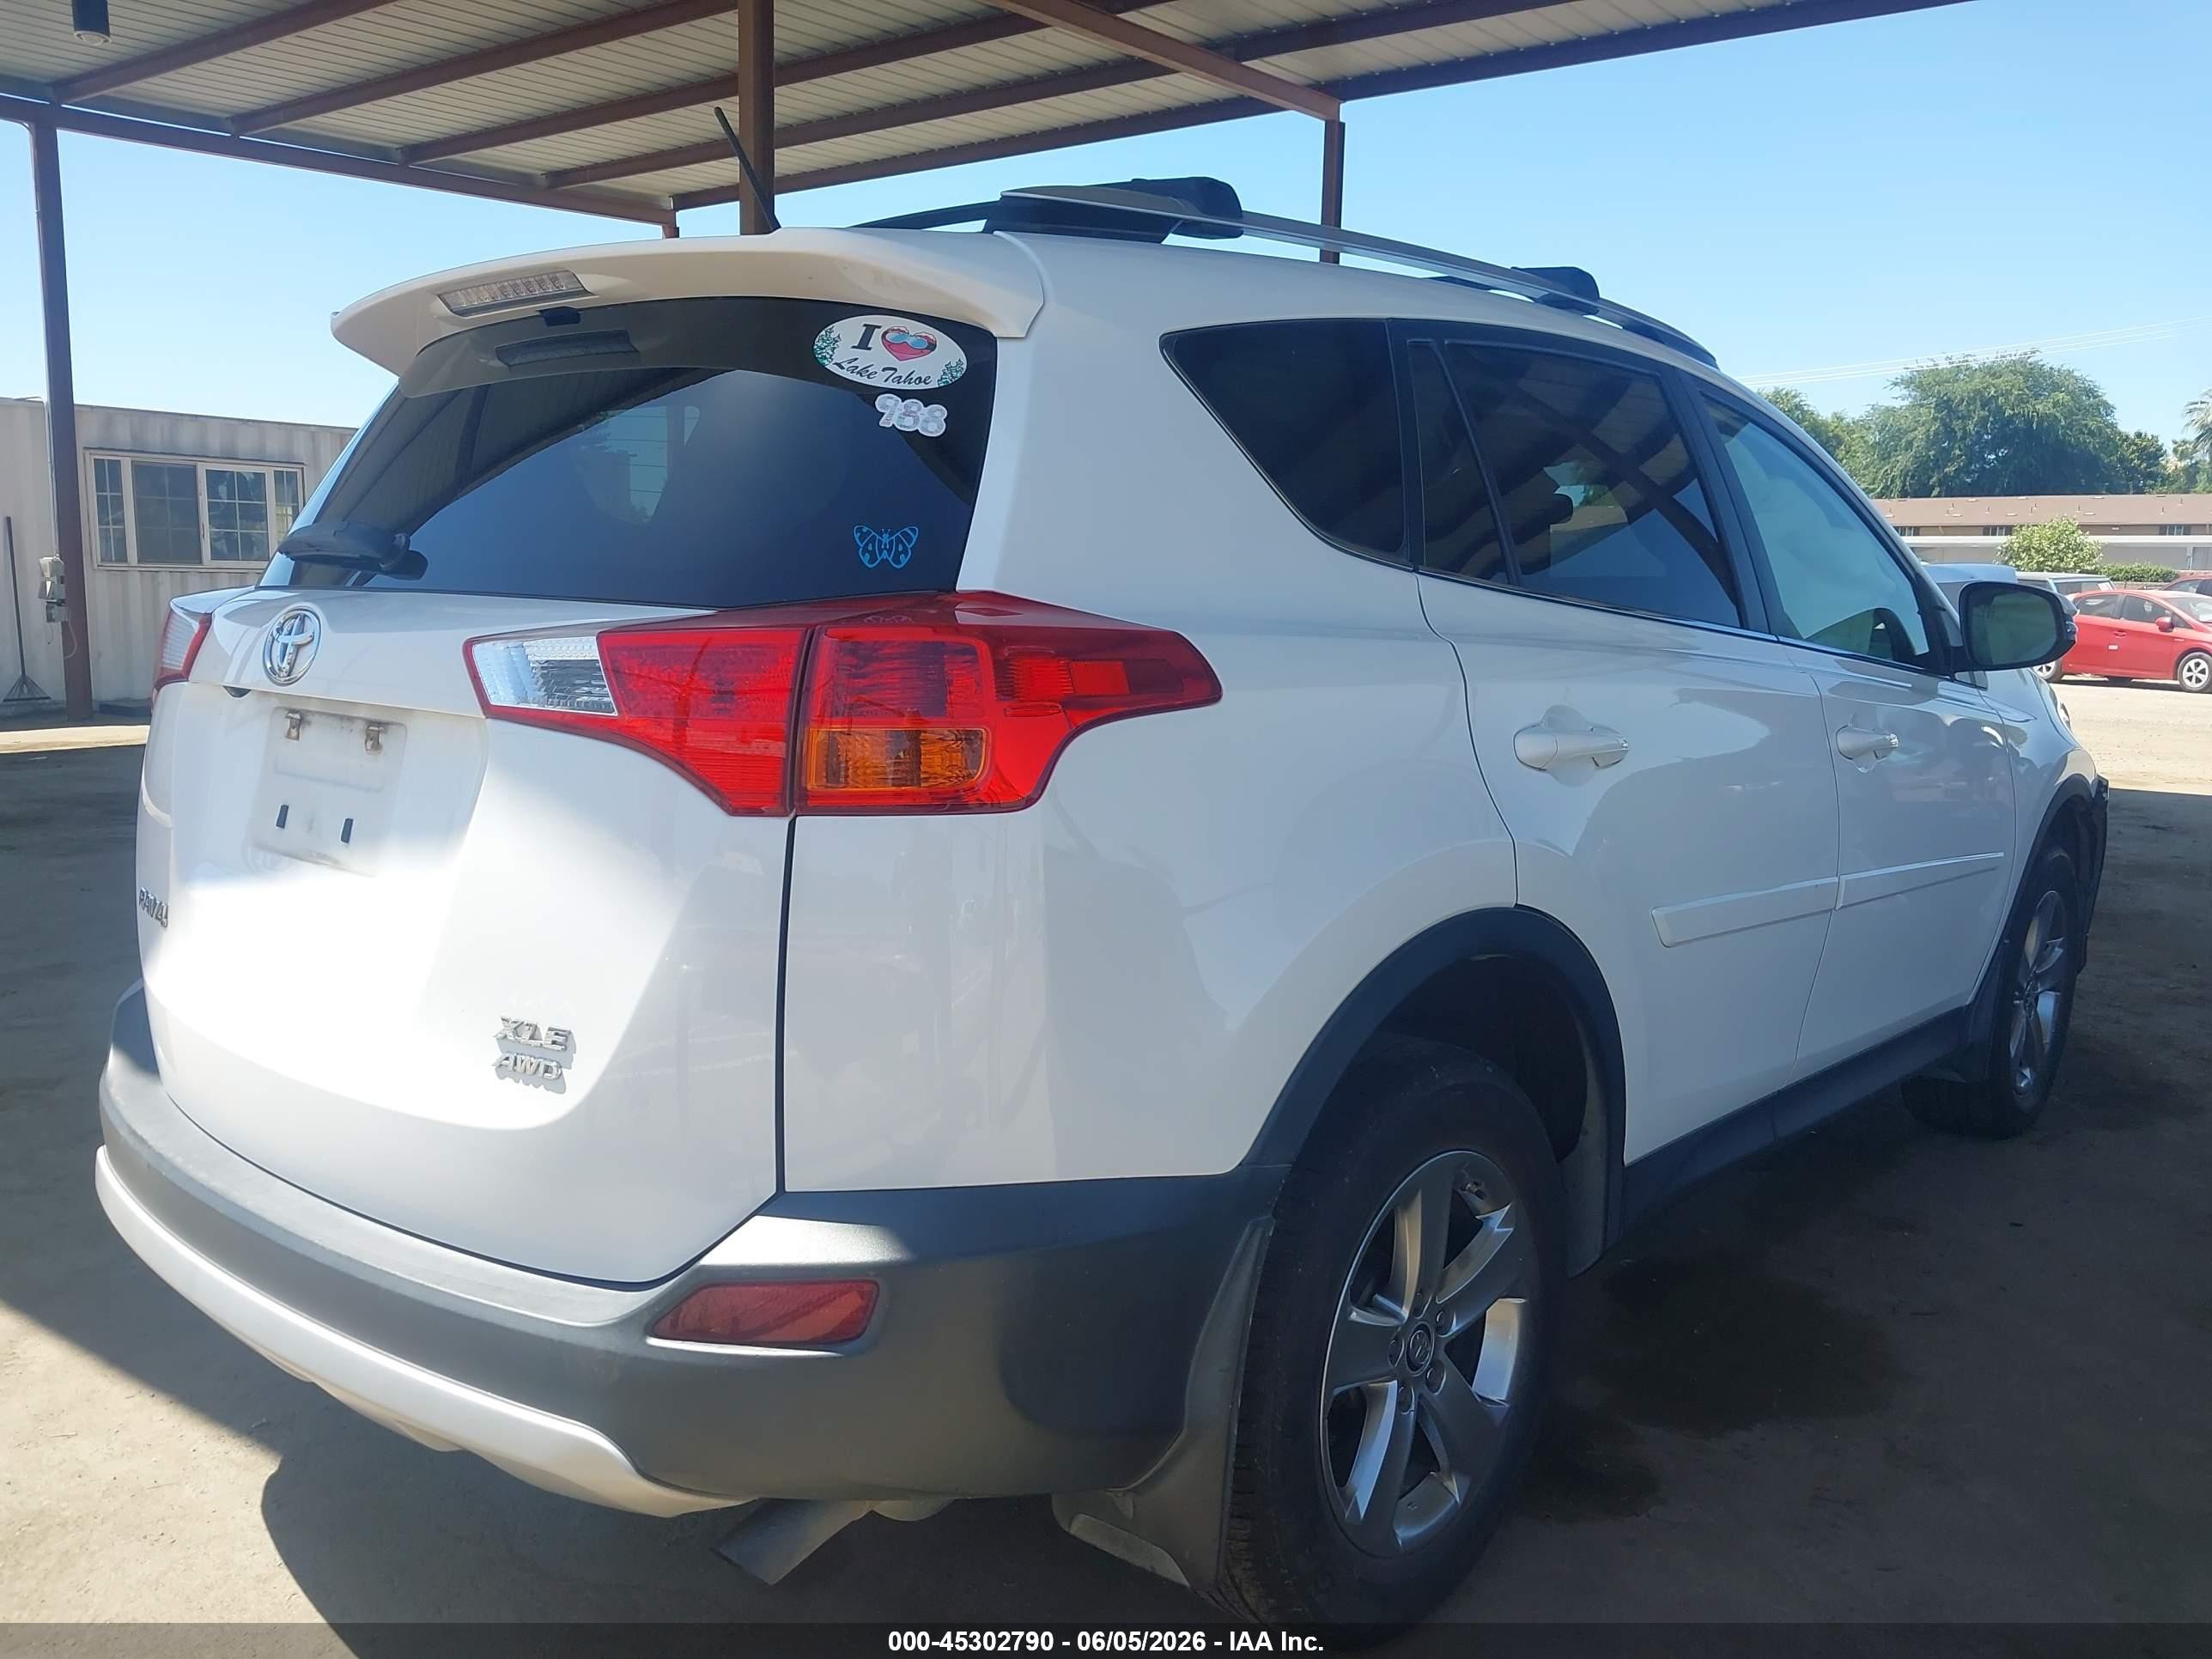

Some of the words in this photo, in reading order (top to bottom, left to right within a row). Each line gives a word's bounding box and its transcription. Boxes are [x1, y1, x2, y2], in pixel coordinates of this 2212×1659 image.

[851, 324, 882, 350] I
[832, 357, 878, 380] Lake
[881, 367, 933, 386] Tahoe
[494, 1017, 571, 1051] XLE
[492, 1052, 562, 1079] AWD
